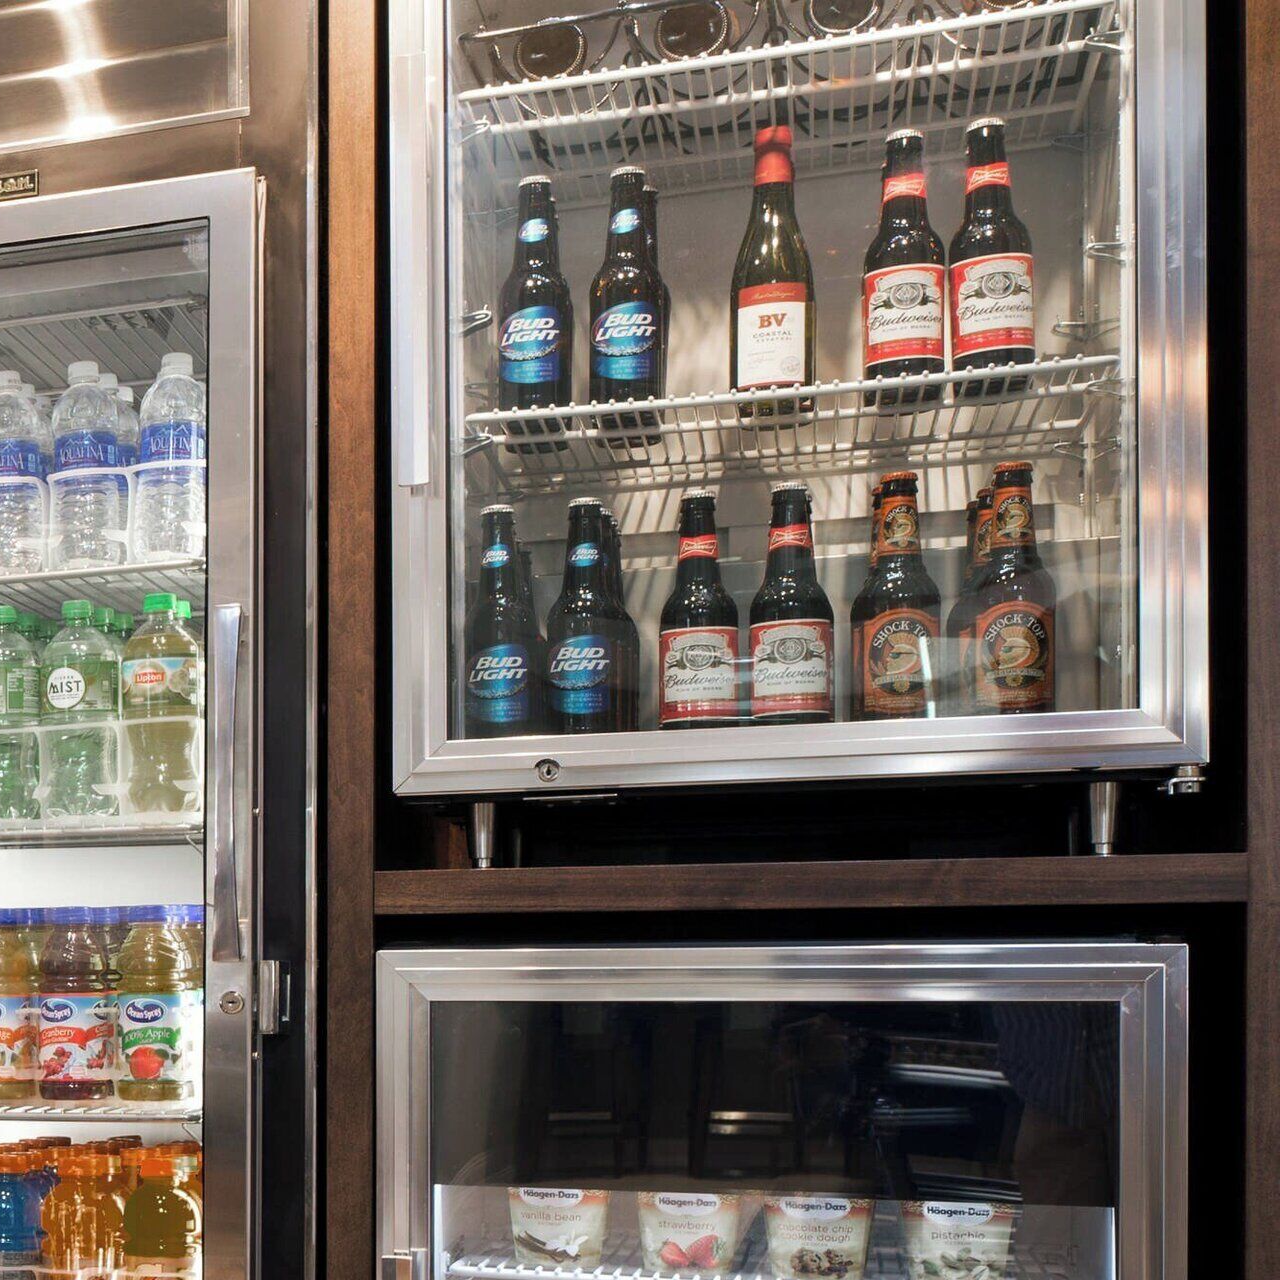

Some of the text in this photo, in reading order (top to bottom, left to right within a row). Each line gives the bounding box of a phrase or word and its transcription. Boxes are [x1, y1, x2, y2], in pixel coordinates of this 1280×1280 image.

[508, 317, 555, 333] BUD
[604, 313, 653, 328] BUD
[758, 313, 787, 329] BV
[501, 329, 560, 348] LIGHT
[595, 326, 656, 342] LIGHT
[753, 330, 793, 339] COASTAL
[873, 620, 910, 649] SHOCK
[985, 613, 1045, 643] SHOCK TOP
[557, 647, 605, 660] BUD
[476, 656, 523, 670] BUD
[550, 659, 610, 673] LIGHT
[136, 672, 163, 684] Lipton
[469, 668, 527, 683] LIGHT
[48, 679, 83, 695] MIST
[126, 1006, 163, 1020] Ocean Spray
[146, 1027, 171, 1039] Apple
[522, 1189, 580, 1200] Häagen-Dazs
[658, 1195, 717, 1208] Häagen-Dazs
[521, 1210, 581, 1222] vanilla bean
[658, 1220, 718, 1232] strawberry
[832, 1223, 853, 1235] chip
